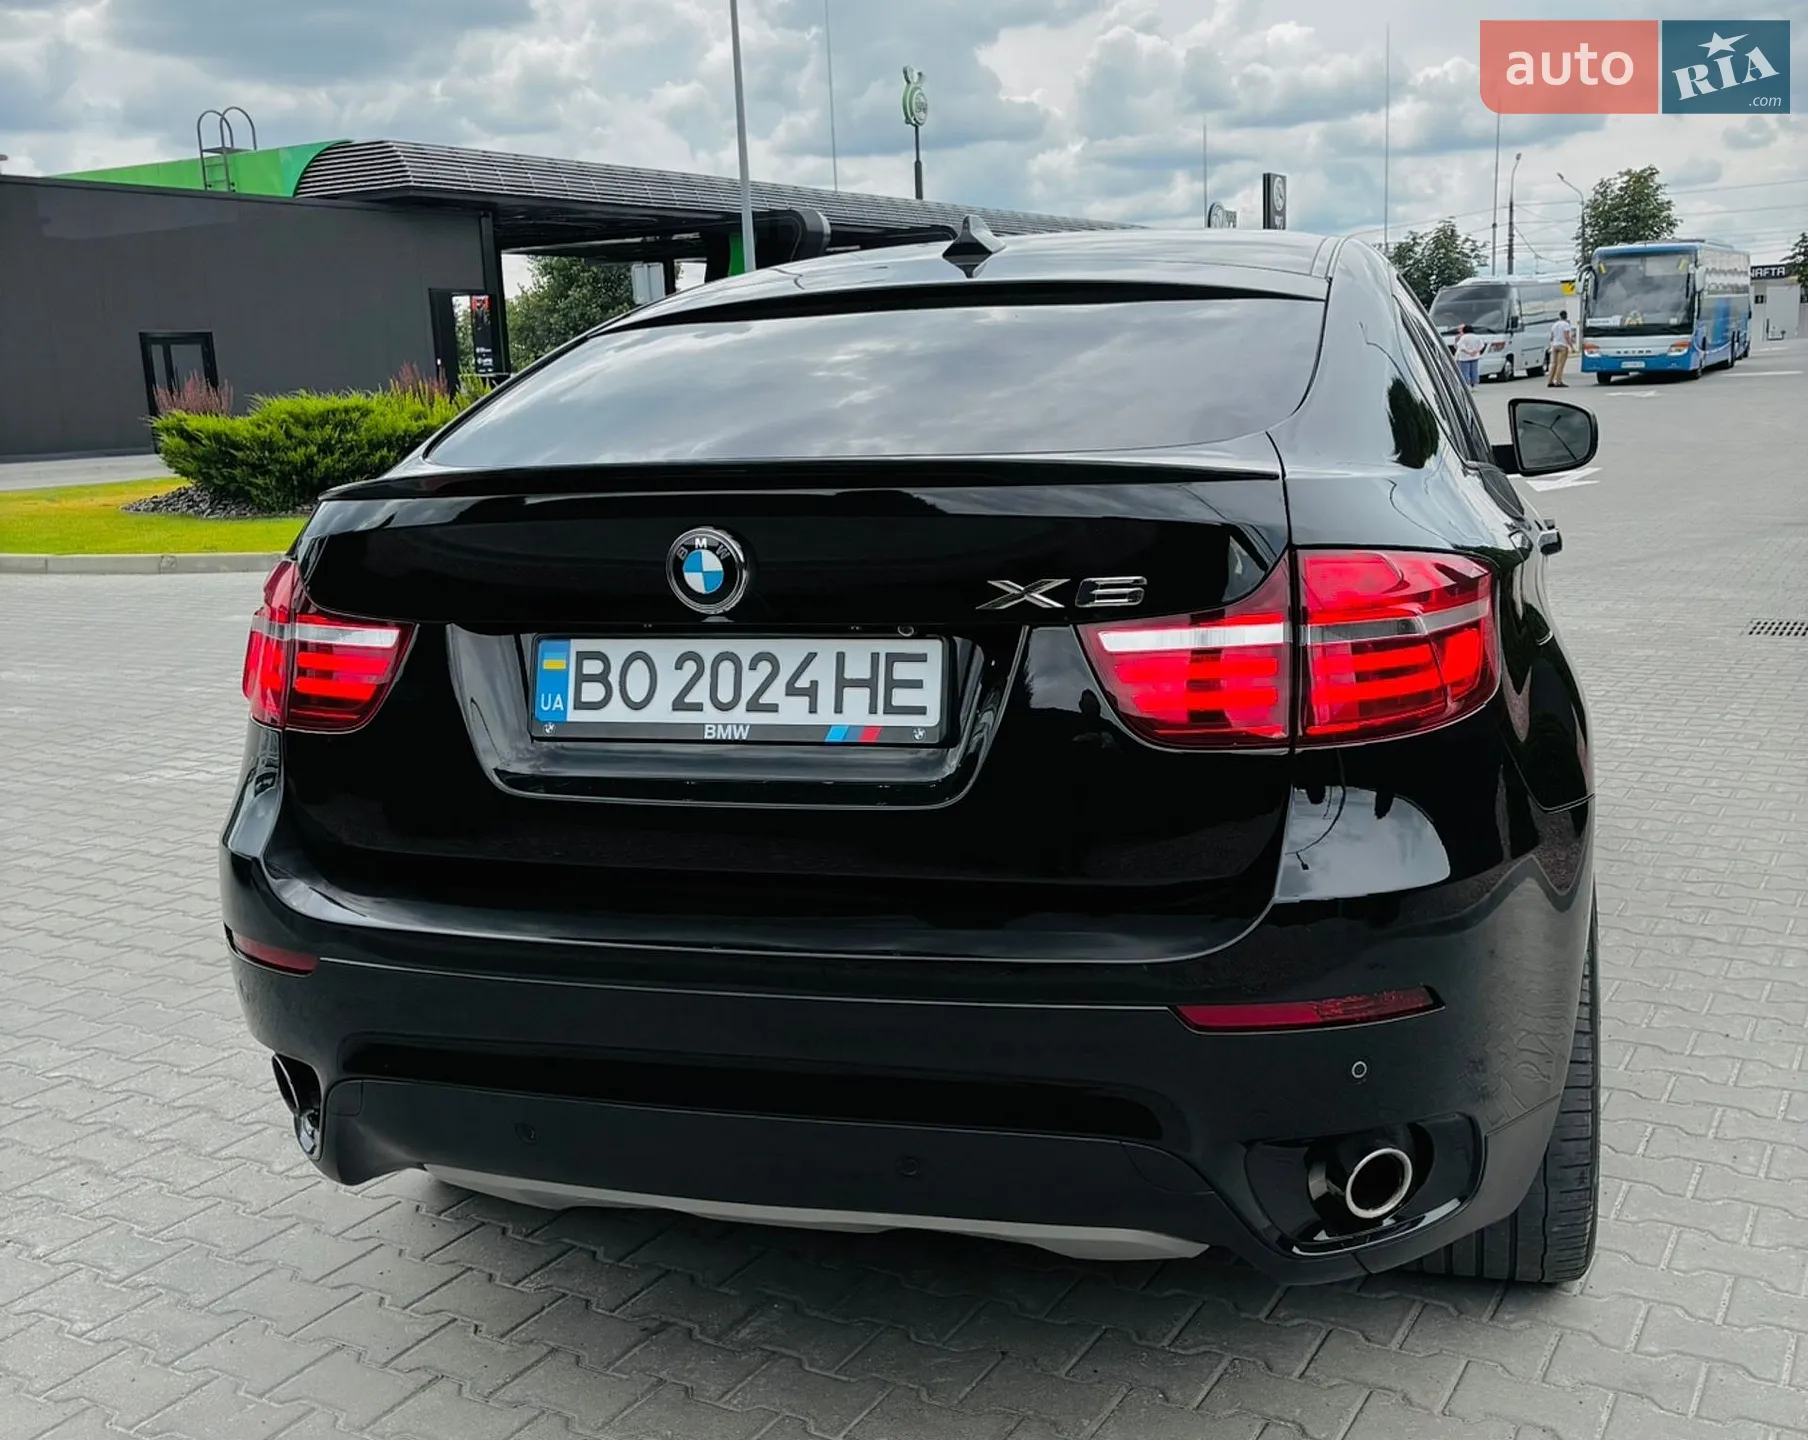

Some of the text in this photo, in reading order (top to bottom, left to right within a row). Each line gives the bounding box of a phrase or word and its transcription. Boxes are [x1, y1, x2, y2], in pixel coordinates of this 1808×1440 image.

[677, 538, 731, 560] BMW
[975, 576, 1148, 610] X6
[573, 650, 928, 715] BO 2024 HE
[541, 693, 564, 711] UA
[704, 724, 750, 740] BMW
